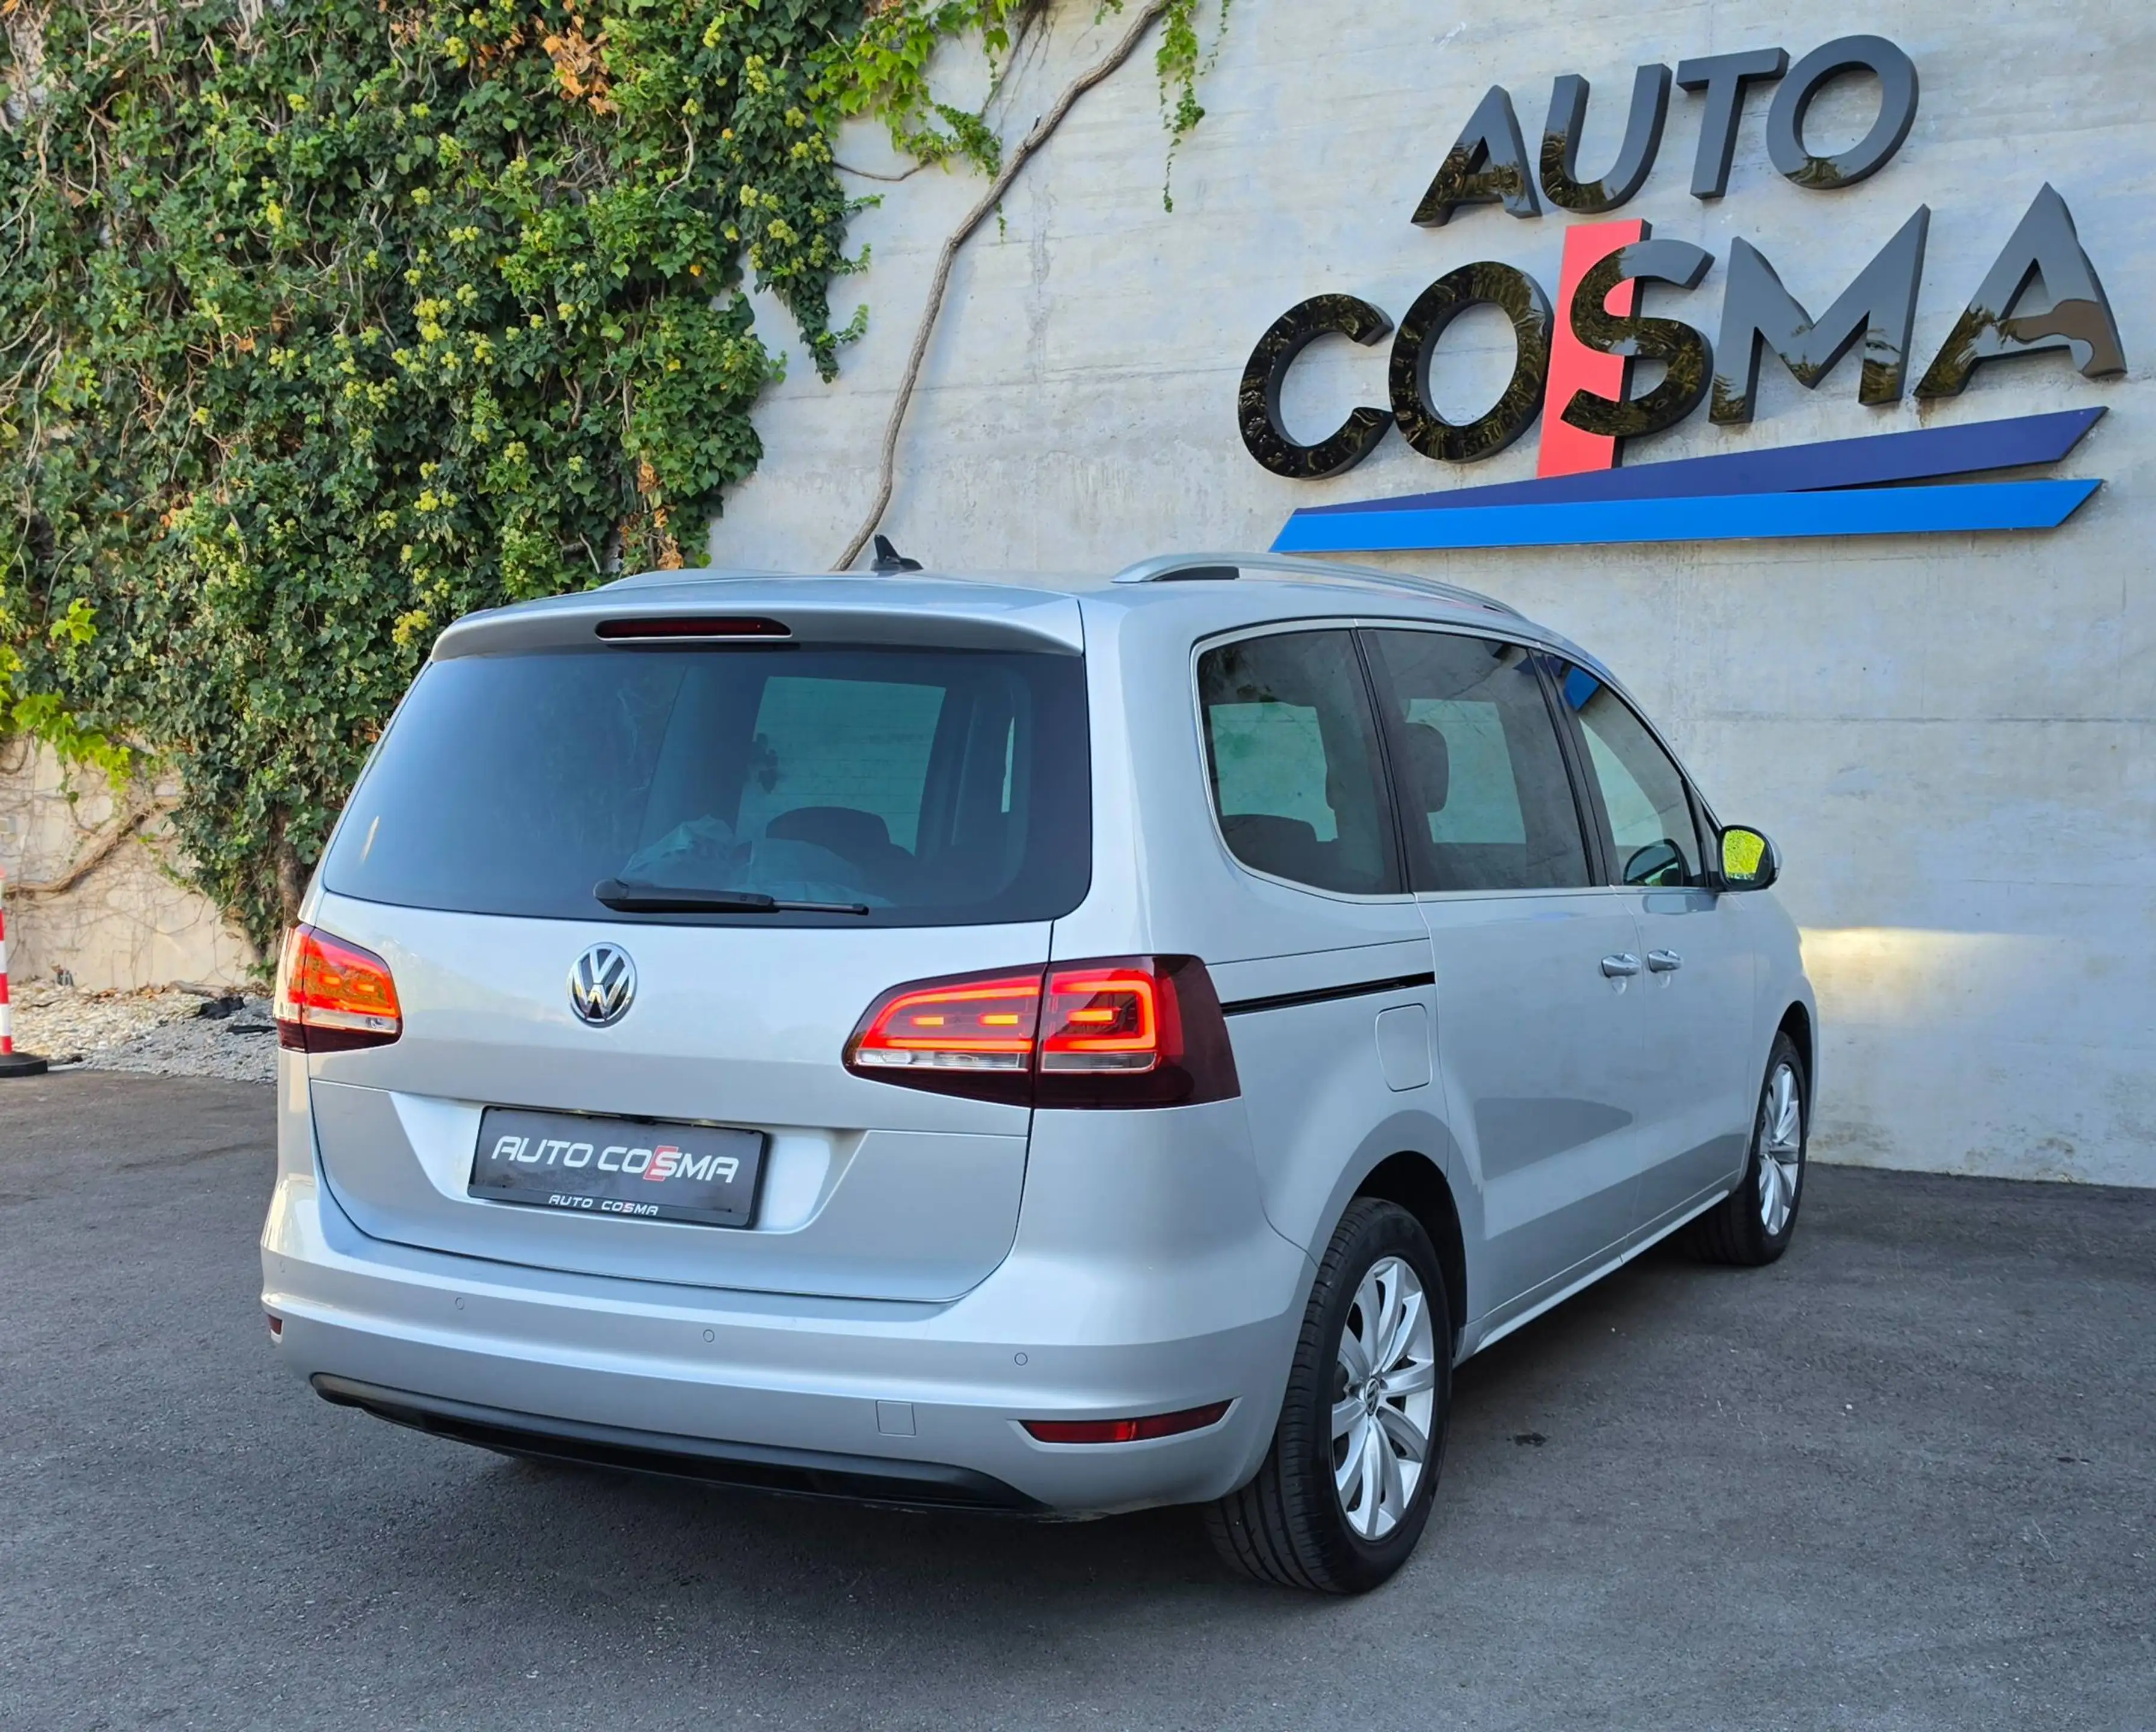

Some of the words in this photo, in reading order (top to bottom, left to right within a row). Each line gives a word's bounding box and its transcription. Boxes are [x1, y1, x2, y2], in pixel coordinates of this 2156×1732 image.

[1411, 34, 1919, 229] AUTO
[1238, 181, 2128, 481] COSMA
[570, 946, 634, 1022] VW
[491, 1135, 594, 1167] AUTO
[597, 1146, 740, 1184] COSMA
[548, 1194, 593, 1209] AUTO
[601, 1200, 659, 1216] COSMA
